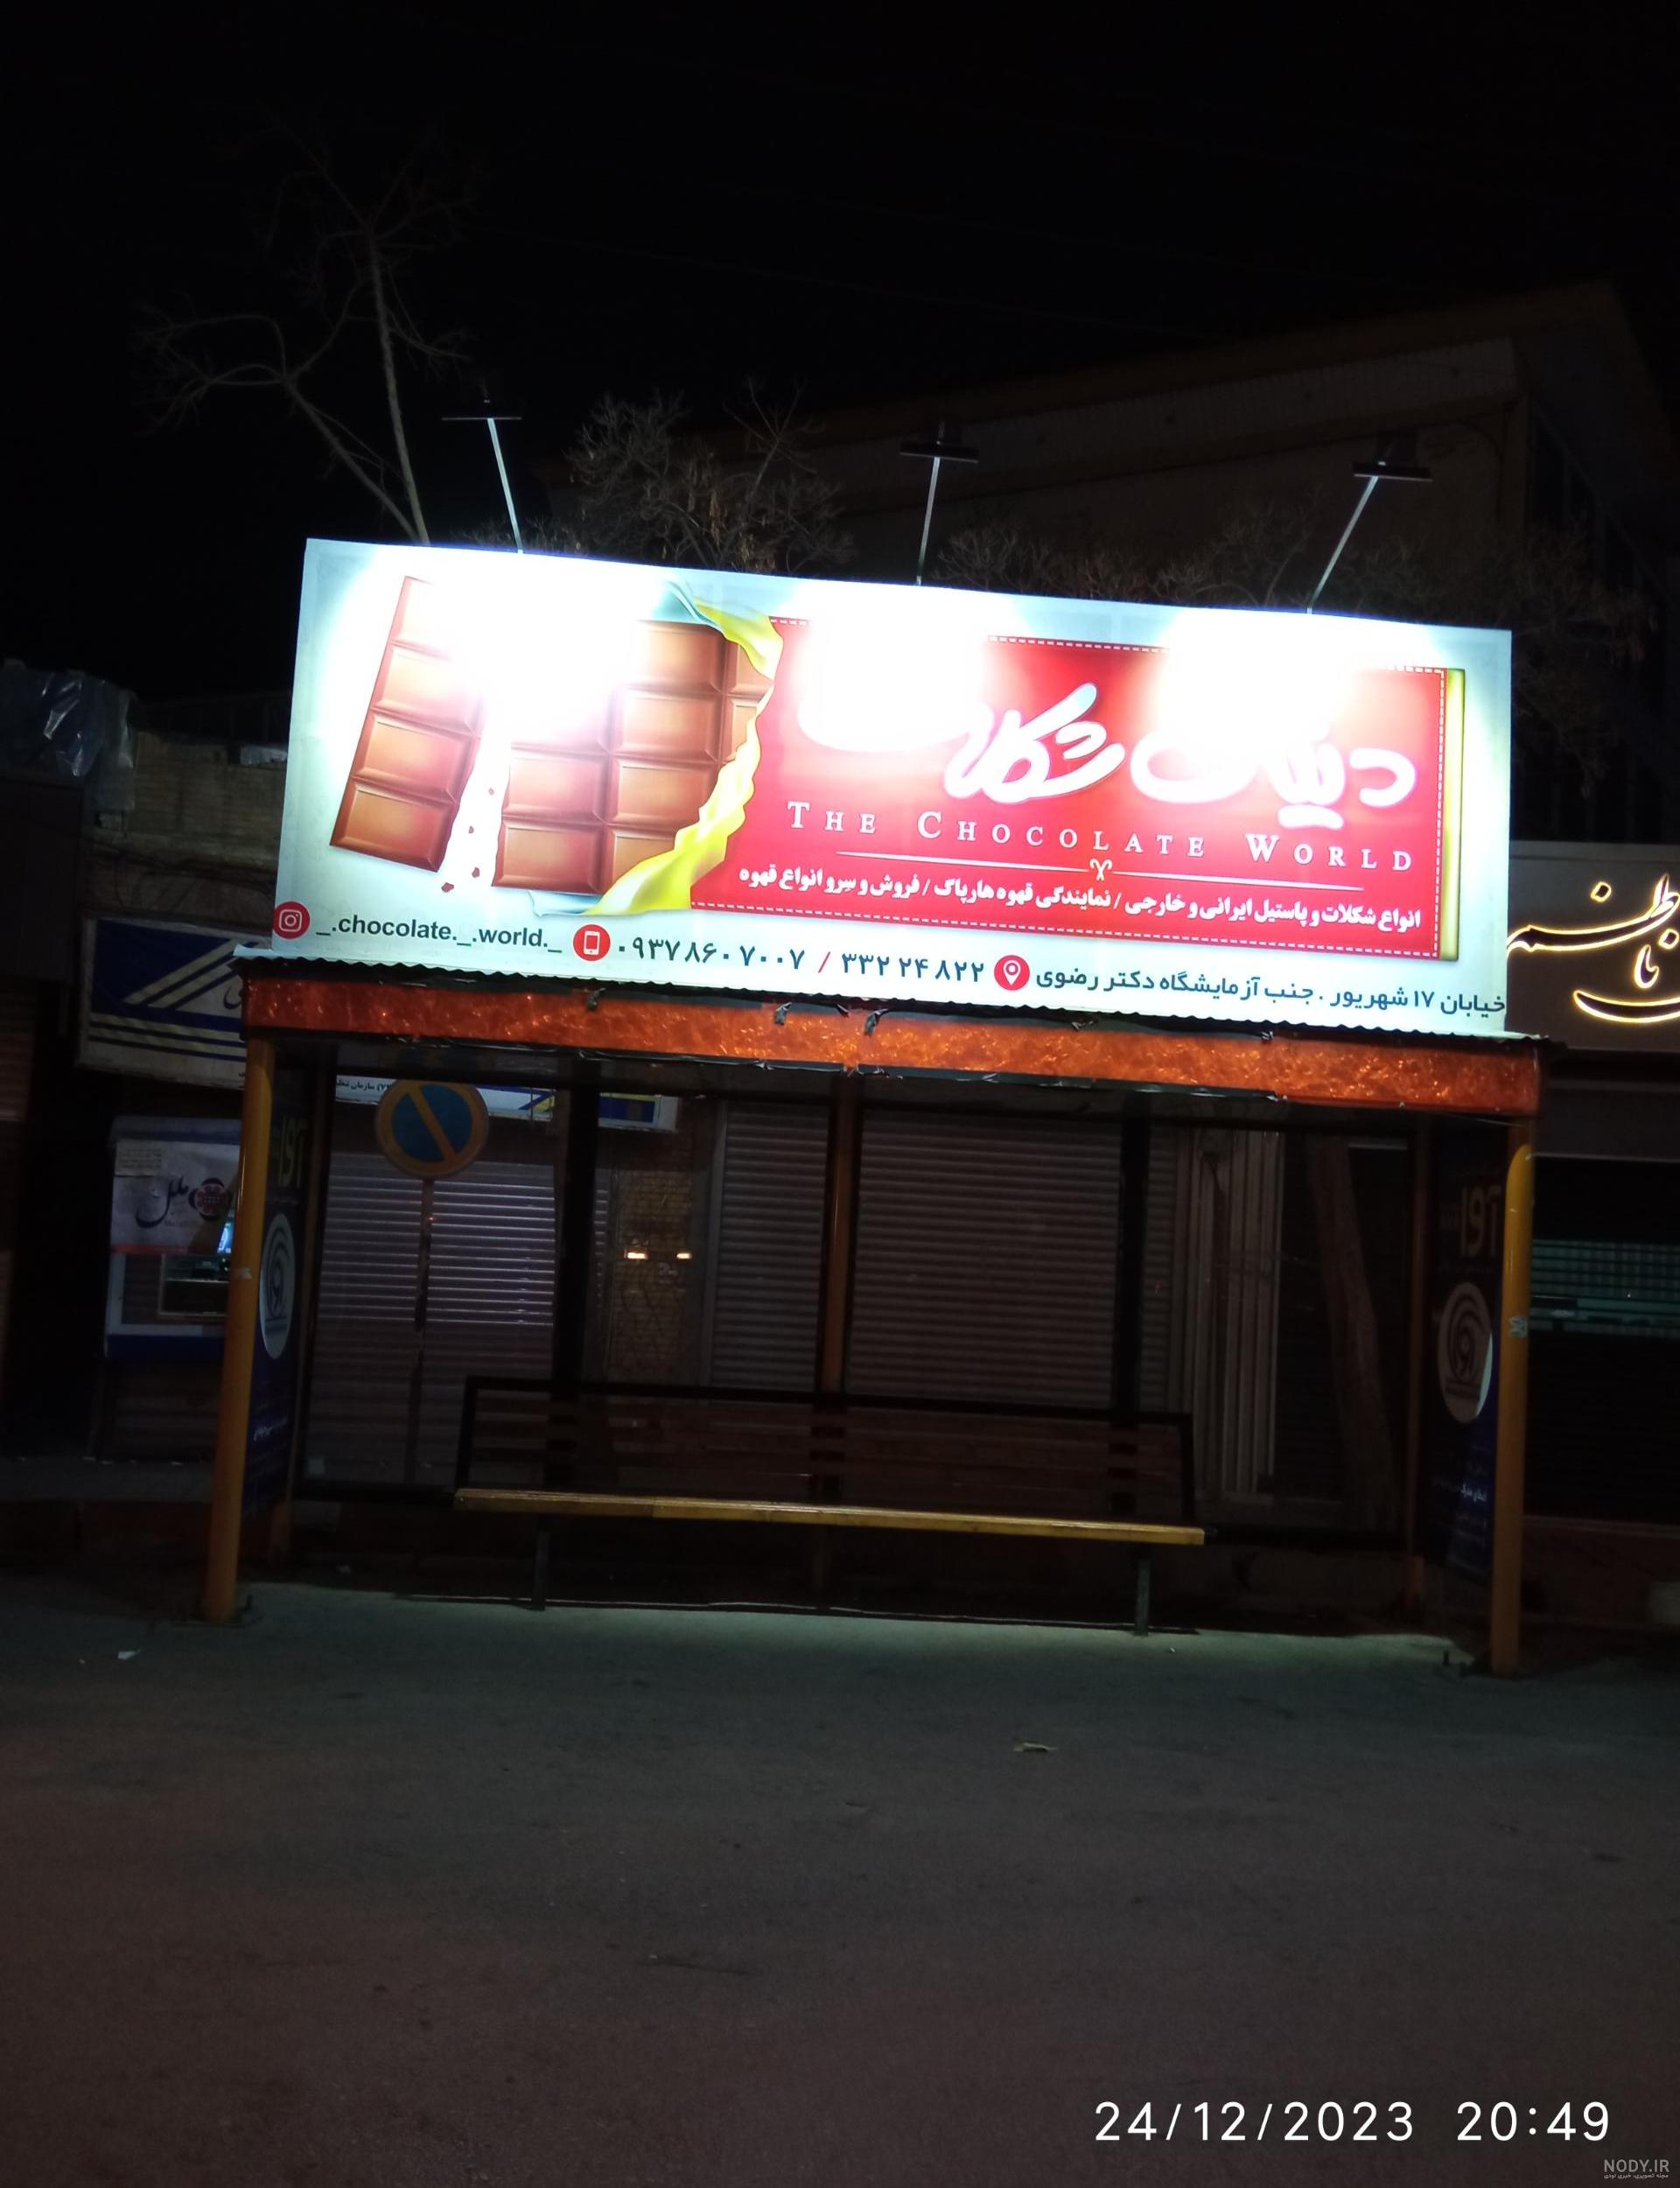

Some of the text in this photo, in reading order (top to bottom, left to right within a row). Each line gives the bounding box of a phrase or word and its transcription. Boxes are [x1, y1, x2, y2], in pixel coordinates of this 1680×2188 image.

[738, 864, 778, 887] قهوه
[779, 866, 823, 891] انواع
[858, 879, 868, 895] و
[870, 873, 920, 899] فروش
[934, 878, 994, 903] هارپاک
[997, 882, 1033, 906] قهوه
[1035, 886, 1111, 910] نمایندگی
[1124, 893, 1186, 916] خارجی
[1187, 901, 1198, 918] و
[1199, 896, 1252, 922] ایرانی
[1254, 899, 1307, 927] پاستیل
[1321, 903, 1376, 925] شکلات
[1309, 910, 1320, 927] و
[1377, 909, 1421, 932] انواع
[316, 915, 563, 952] _.chocolate._.world._
[1036, 967, 1099, 991] رضوی
[1103, 971, 1155, 992] دکتر
[1159, 971, 1261, 1000] آزمایشگاه
[1264, 983, 1313, 1005] جنب
[1330, 986, 1408, 1011] شهریور
[1414, 990, 1435, 1007] ۱۷
[1440, 993, 1505, 1018] خیابان
